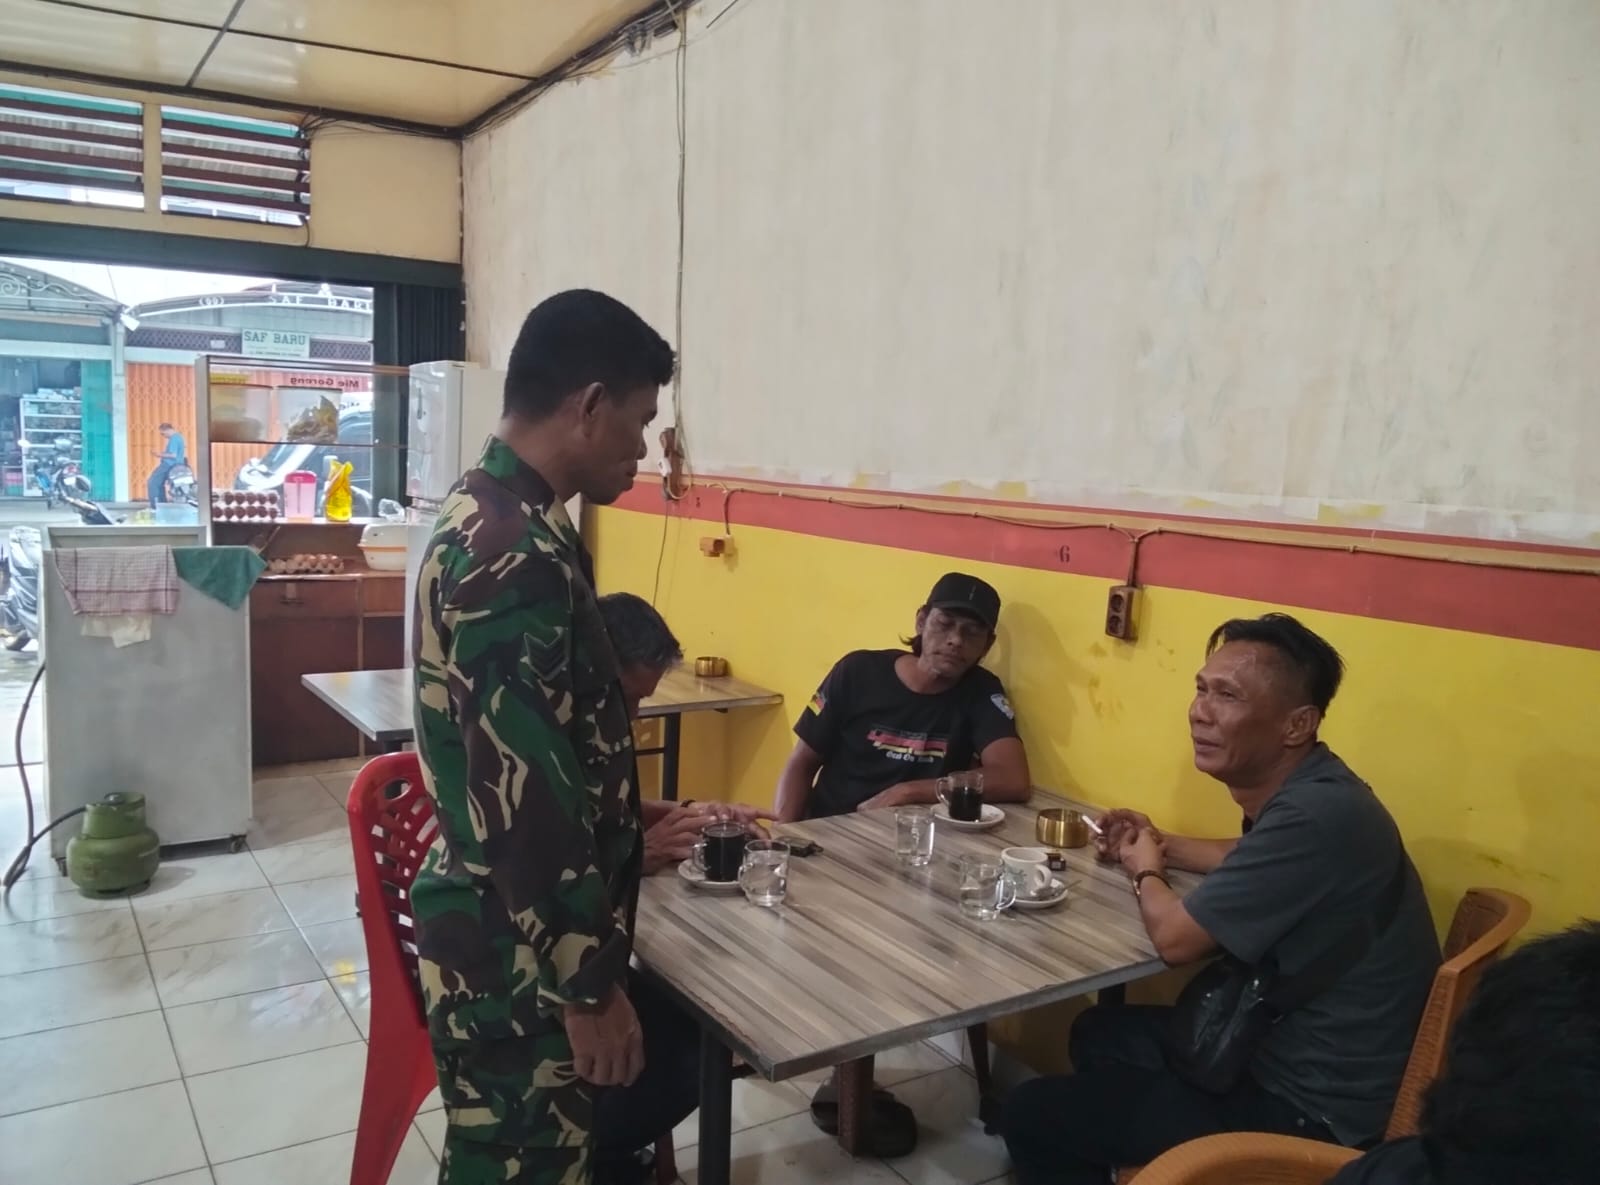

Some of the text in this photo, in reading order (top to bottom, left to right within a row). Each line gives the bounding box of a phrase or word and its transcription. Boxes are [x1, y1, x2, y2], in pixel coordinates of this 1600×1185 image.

[269, 295, 303, 304] SAF
[243, 330, 305, 345] SAF BARU
[1059, 545, 1070, 562] 6
